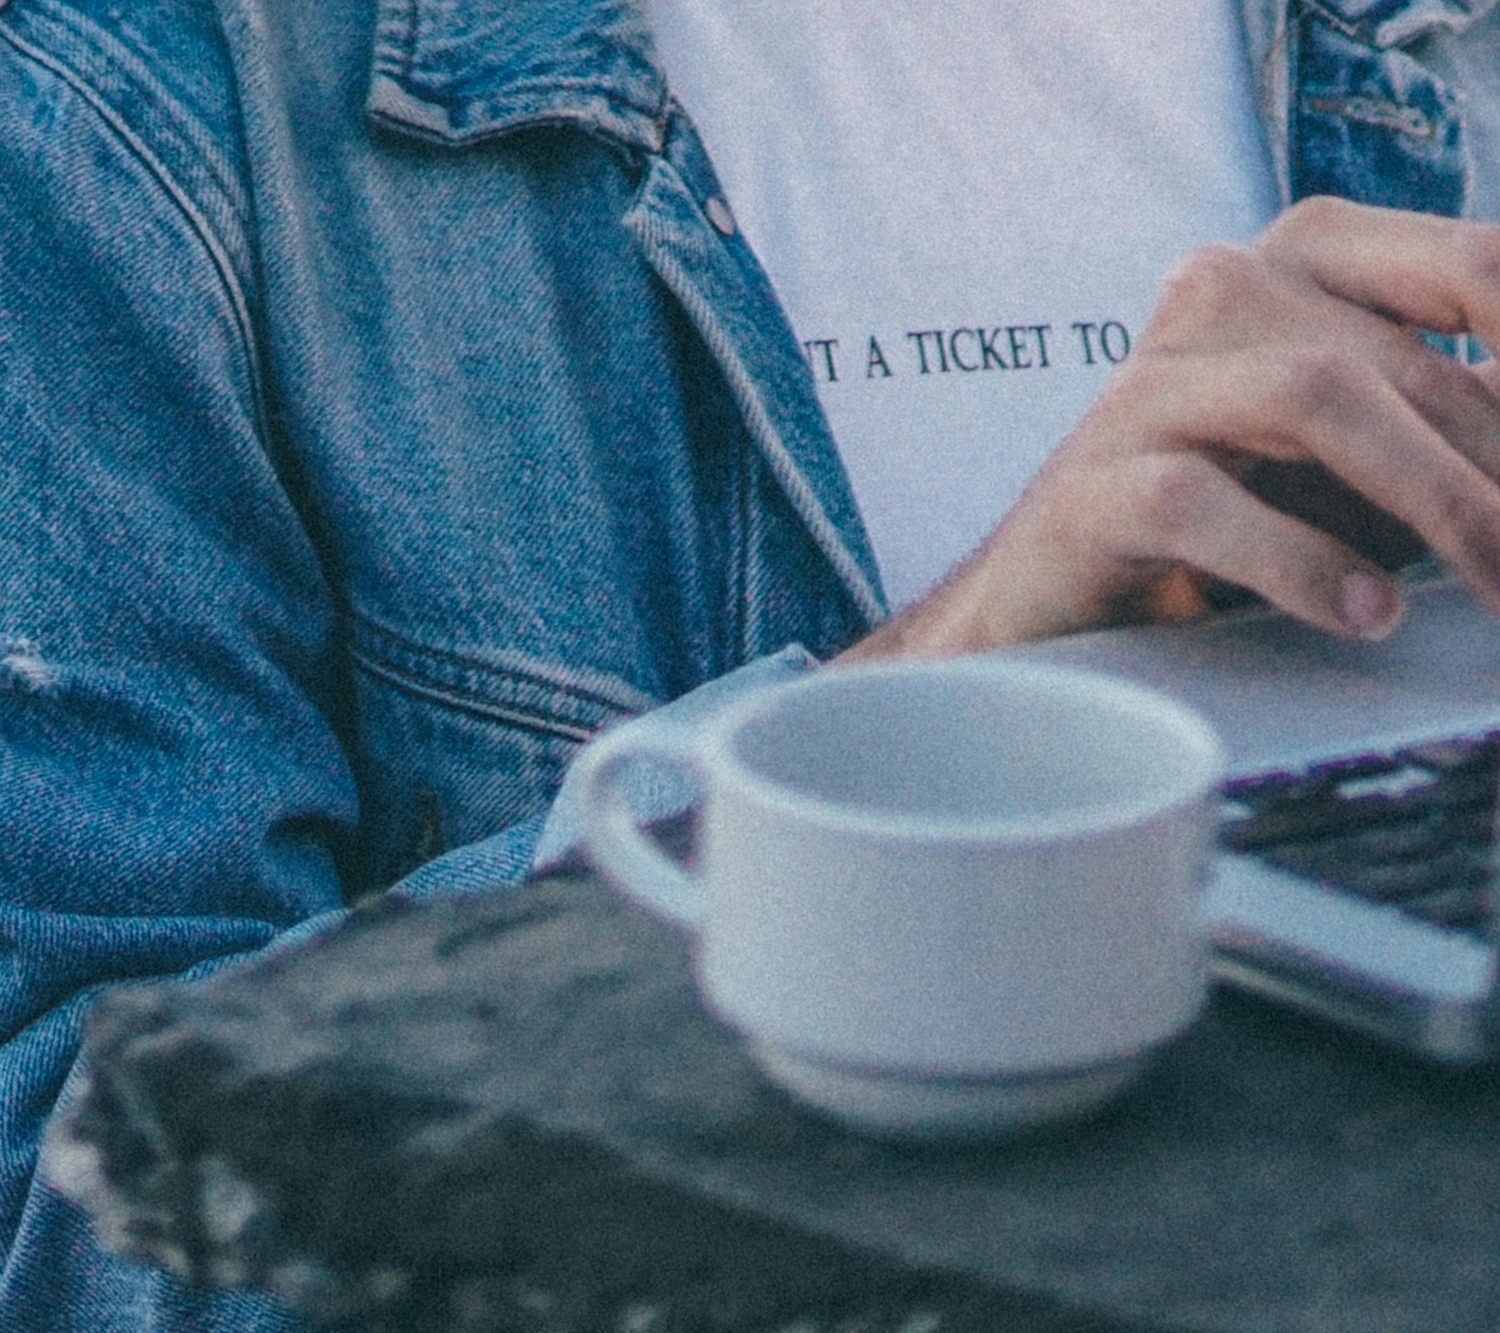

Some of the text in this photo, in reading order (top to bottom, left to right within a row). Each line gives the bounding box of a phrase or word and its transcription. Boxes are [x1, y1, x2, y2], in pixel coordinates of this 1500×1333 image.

[866, 335, 893, 379] A
[906, 324, 1051, 374] TICKET
[1071, 321, 1131, 364] TO
